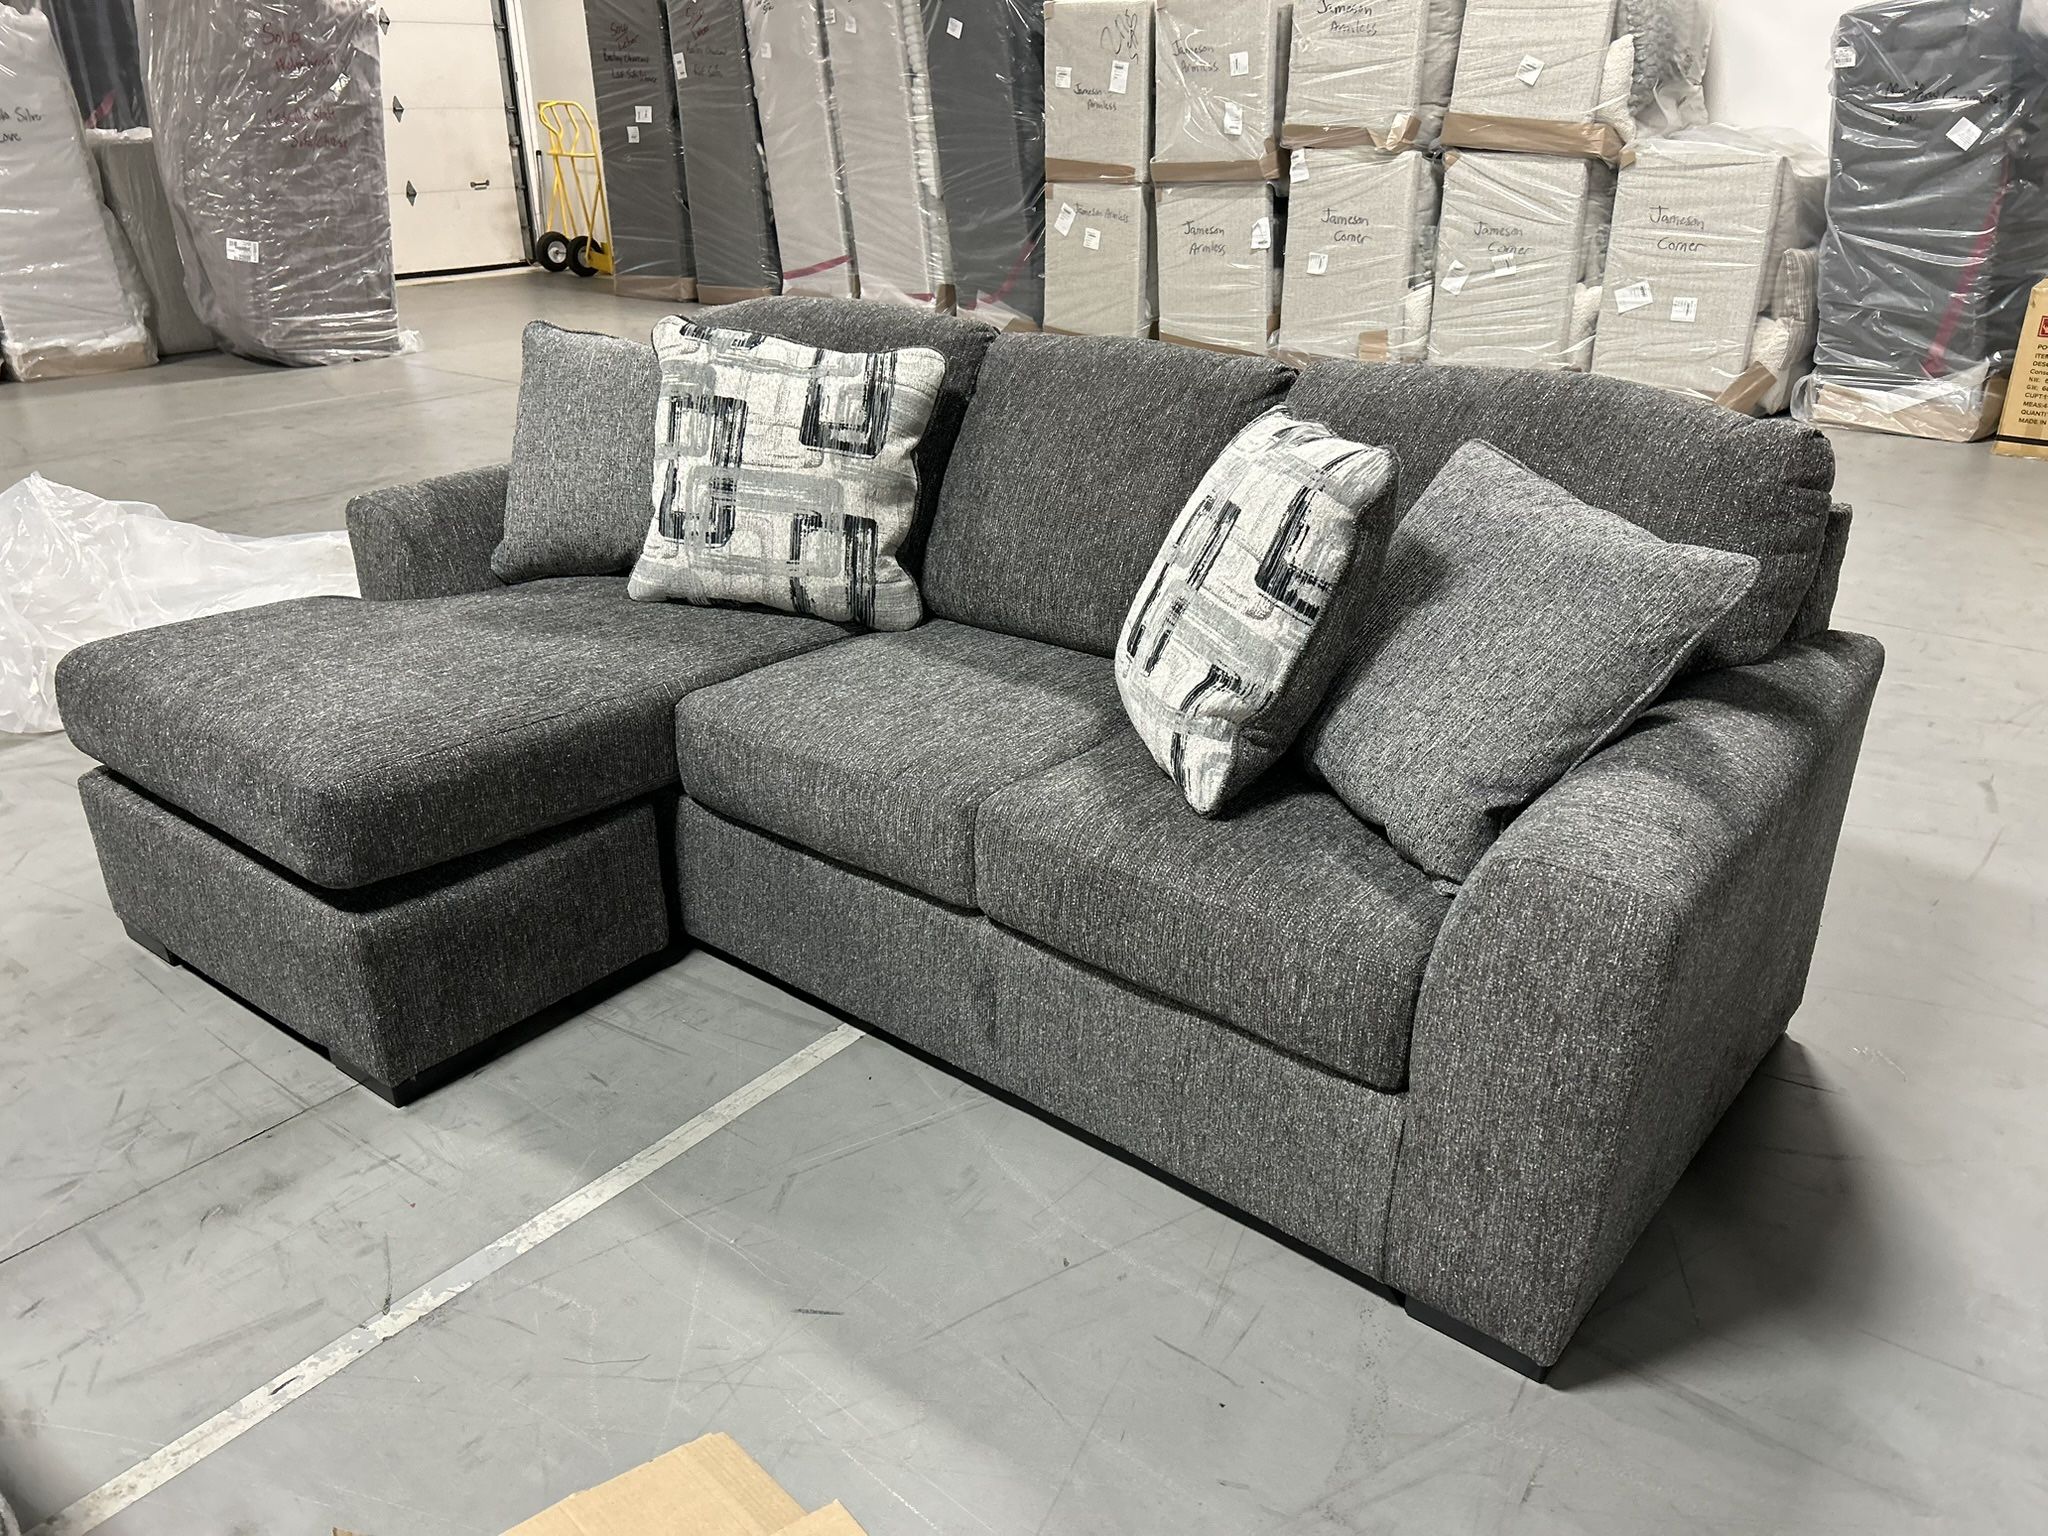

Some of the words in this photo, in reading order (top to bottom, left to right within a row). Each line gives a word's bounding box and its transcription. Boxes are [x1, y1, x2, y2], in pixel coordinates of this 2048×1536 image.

[1321, 207, 1369, 226] Jameson
[1649, 205, 1704, 230] Jameson
[1182, 220, 1225, 236] Jameson
[1473, 220, 1523, 237] Jameson
[1333, 229, 1373, 244] Corner
[1657, 236, 1708, 252] Corner
[1189, 241, 1227, 256] Armless
[1487, 240, 1536, 255] Corner
[2018, 417, 2038, 425] MADE
